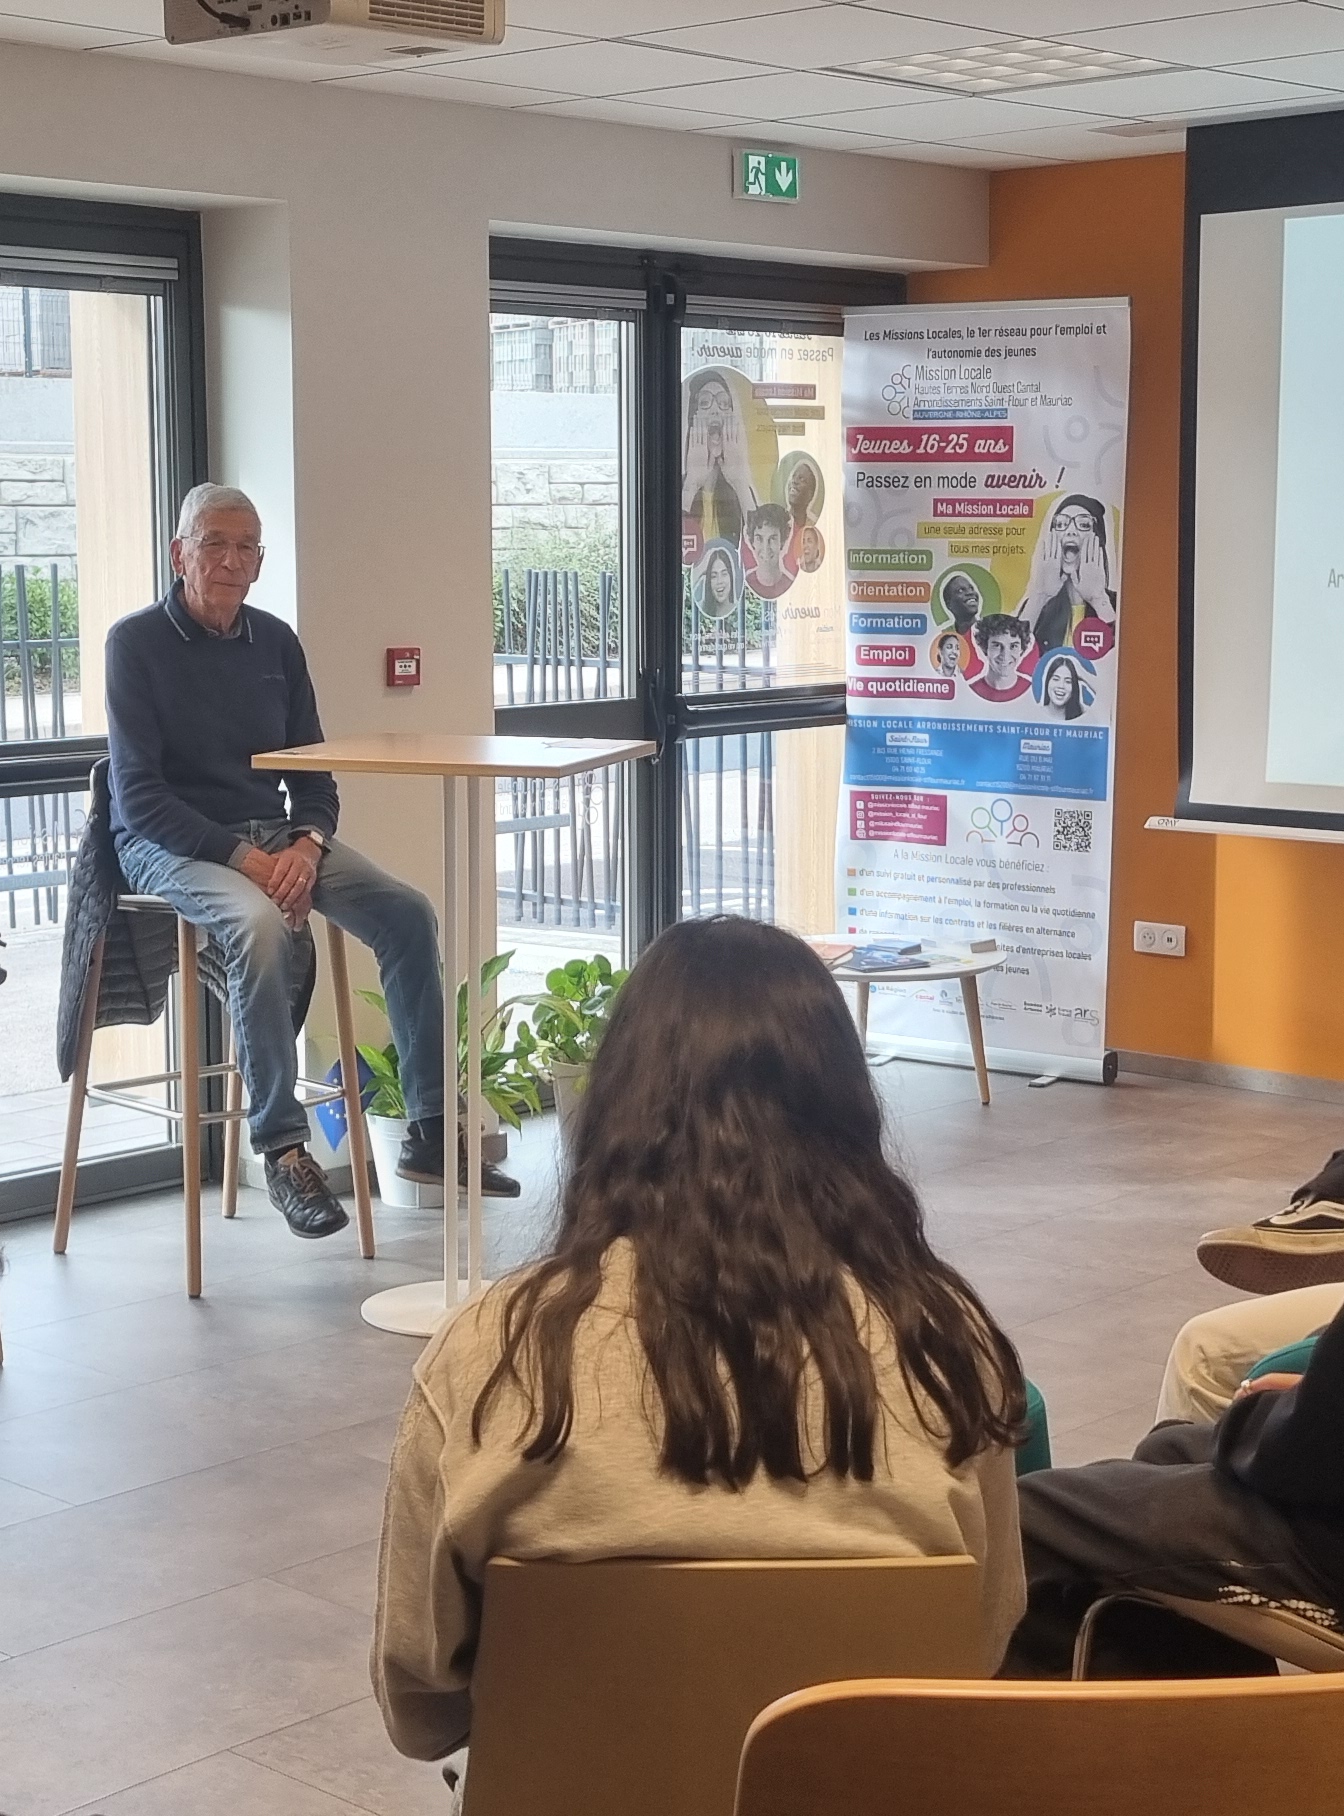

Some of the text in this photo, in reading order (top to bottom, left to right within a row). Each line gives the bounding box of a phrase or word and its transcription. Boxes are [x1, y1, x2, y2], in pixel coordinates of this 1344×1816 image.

[864, 330, 880, 341] Les
[883, 328, 924, 340] Missions
[927, 328, 964, 340] Locales,
[966, 327, 975, 338] le
[994, 326, 1027, 338] réseau
[1030, 327, 1052, 339] pour
[1055, 324, 1092, 337] l'emploi
[1096, 324, 1107, 335] et
[927, 346, 1037, 359] l'autonomie des jeunes
[915, 365, 992, 381] Mission Locale
[914, 382, 1041, 395] Hautes Terres Nord Ouest Cantal
[1040, 395, 1073, 407] Mauriac
[851, 434, 1009, 454] Jeunes 16-25 ans
[856, 471, 910, 488] Passez
[914, 475, 932, 488] en
[937, 471, 976, 488] mode
[984, 468, 1047, 489] avenir
[937, 501, 1029, 515] Ma Mission Locale
[924, 526, 940, 535] une
[968, 525, 1003, 536] adresse
[1005, 527, 1026, 538] pour
[950, 543, 1026, 556] tous mes projets.
[849, 552, 927, 564] Information
[850, 583, 925, 596] Orientation
[851, 614, 921, 628] Formation
[861, 647, 910, 662] Emploi
[868, 678, 950, 694] quotidienne
[881, 720, 1104, 740] LOCALE ARRONDISSEMENTS SAINT-FLOUR ET MAURIAC
[901, 849, 1045, 873] la Mission Locale vous bénéficiez
[973, 879, 985, 888] par
[987, 879, 1000, 889] des
[983, 900, 1019, 911] formation
[1020, 904, 1030, 913] ou
[1040, 907, 1050, 915] vie
[1052, 908, 1096, 919] quotidienne
[945, 917, 975, 928] contrats
[1026, 926, 1035, 934] en
[1005, 965, 1030, 975] jeunes
[1075, 1007, 1100, 1026] ars
